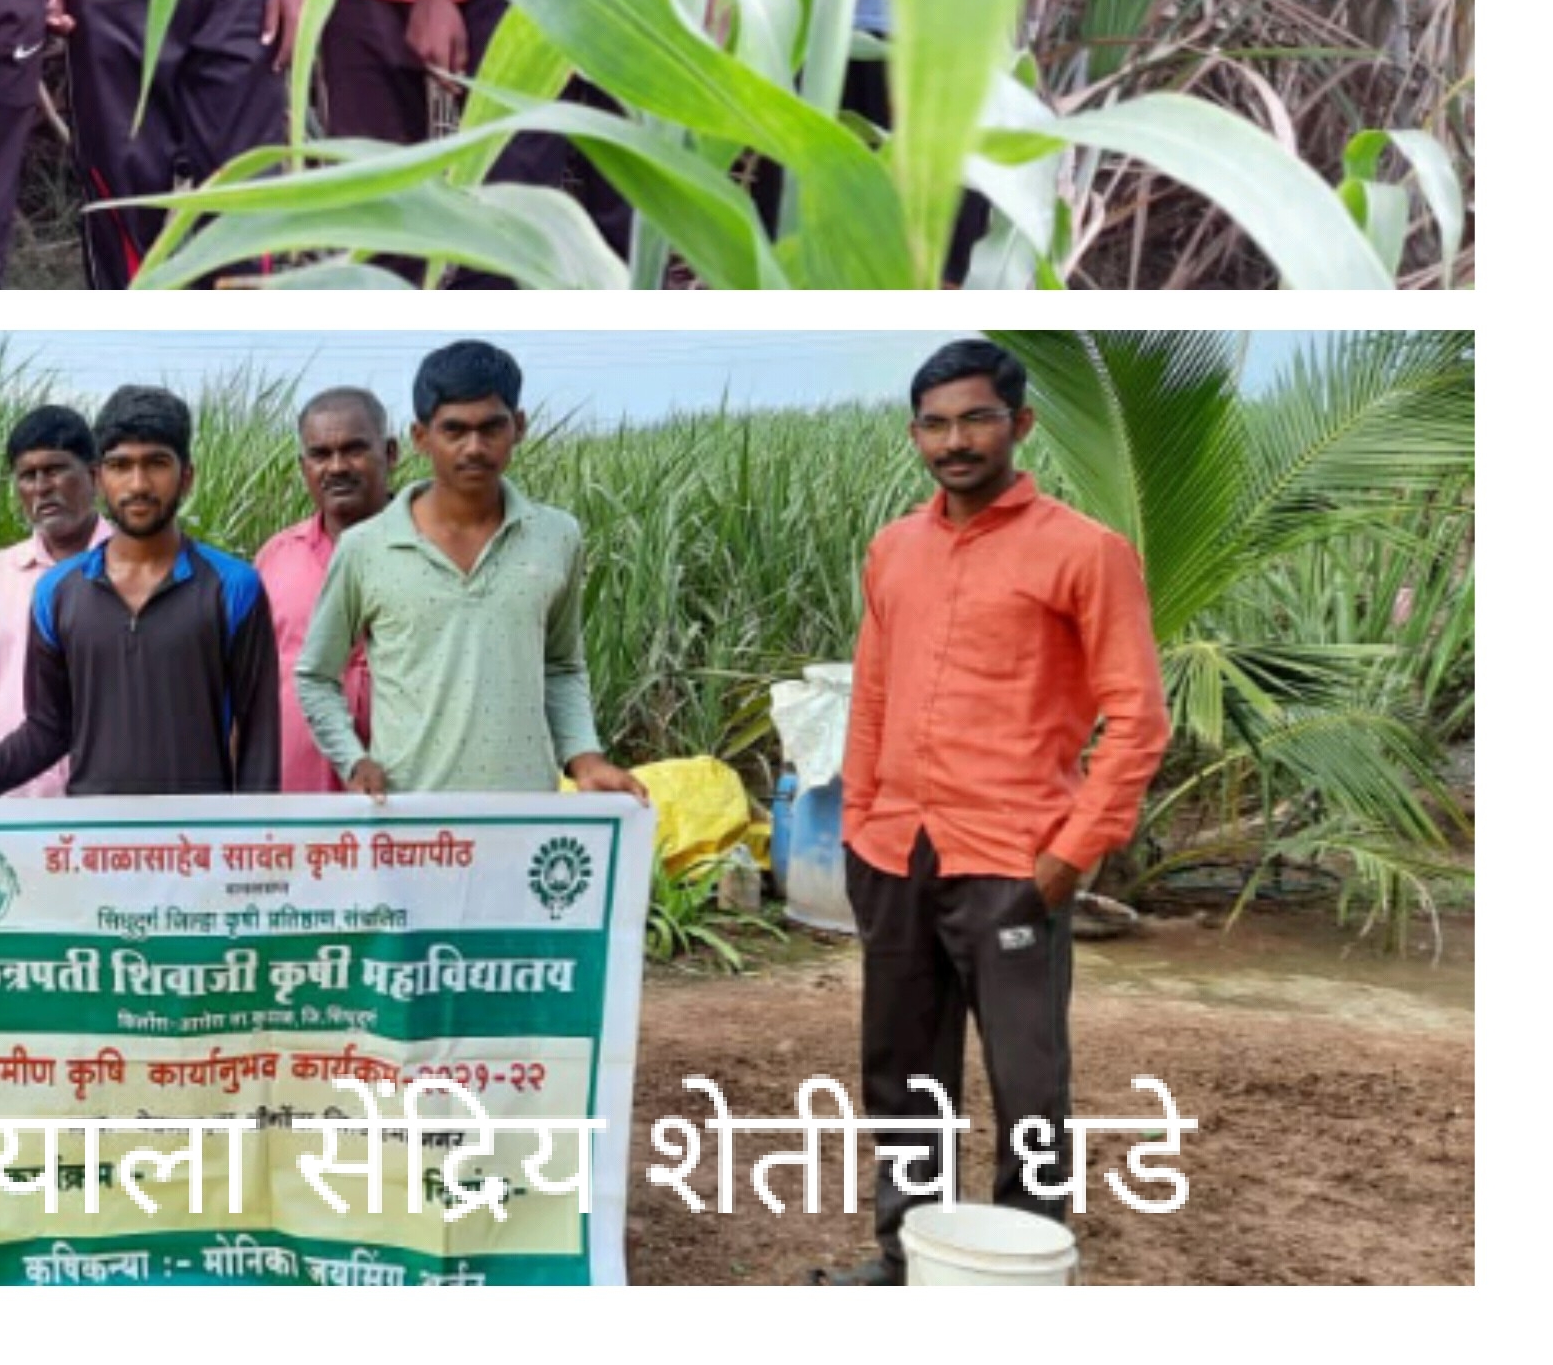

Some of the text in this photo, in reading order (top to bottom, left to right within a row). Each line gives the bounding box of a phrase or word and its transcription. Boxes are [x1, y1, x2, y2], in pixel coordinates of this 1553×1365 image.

[43, 829, 475, 880] डॉ.बाळासाहेब सावंत कृषी विद्यापीठ
[111, 945, 257, 997] शिवाजी
[269, 944, 350, 1004] कृषी
[67, 1044, 126, 1101] कृषि
[148, 1047, 279, 1094] कार्यानुभव
[22, 1241, 150, 1284] कषिकन्या
[201, 1233, 301, 1279] मोनिका
